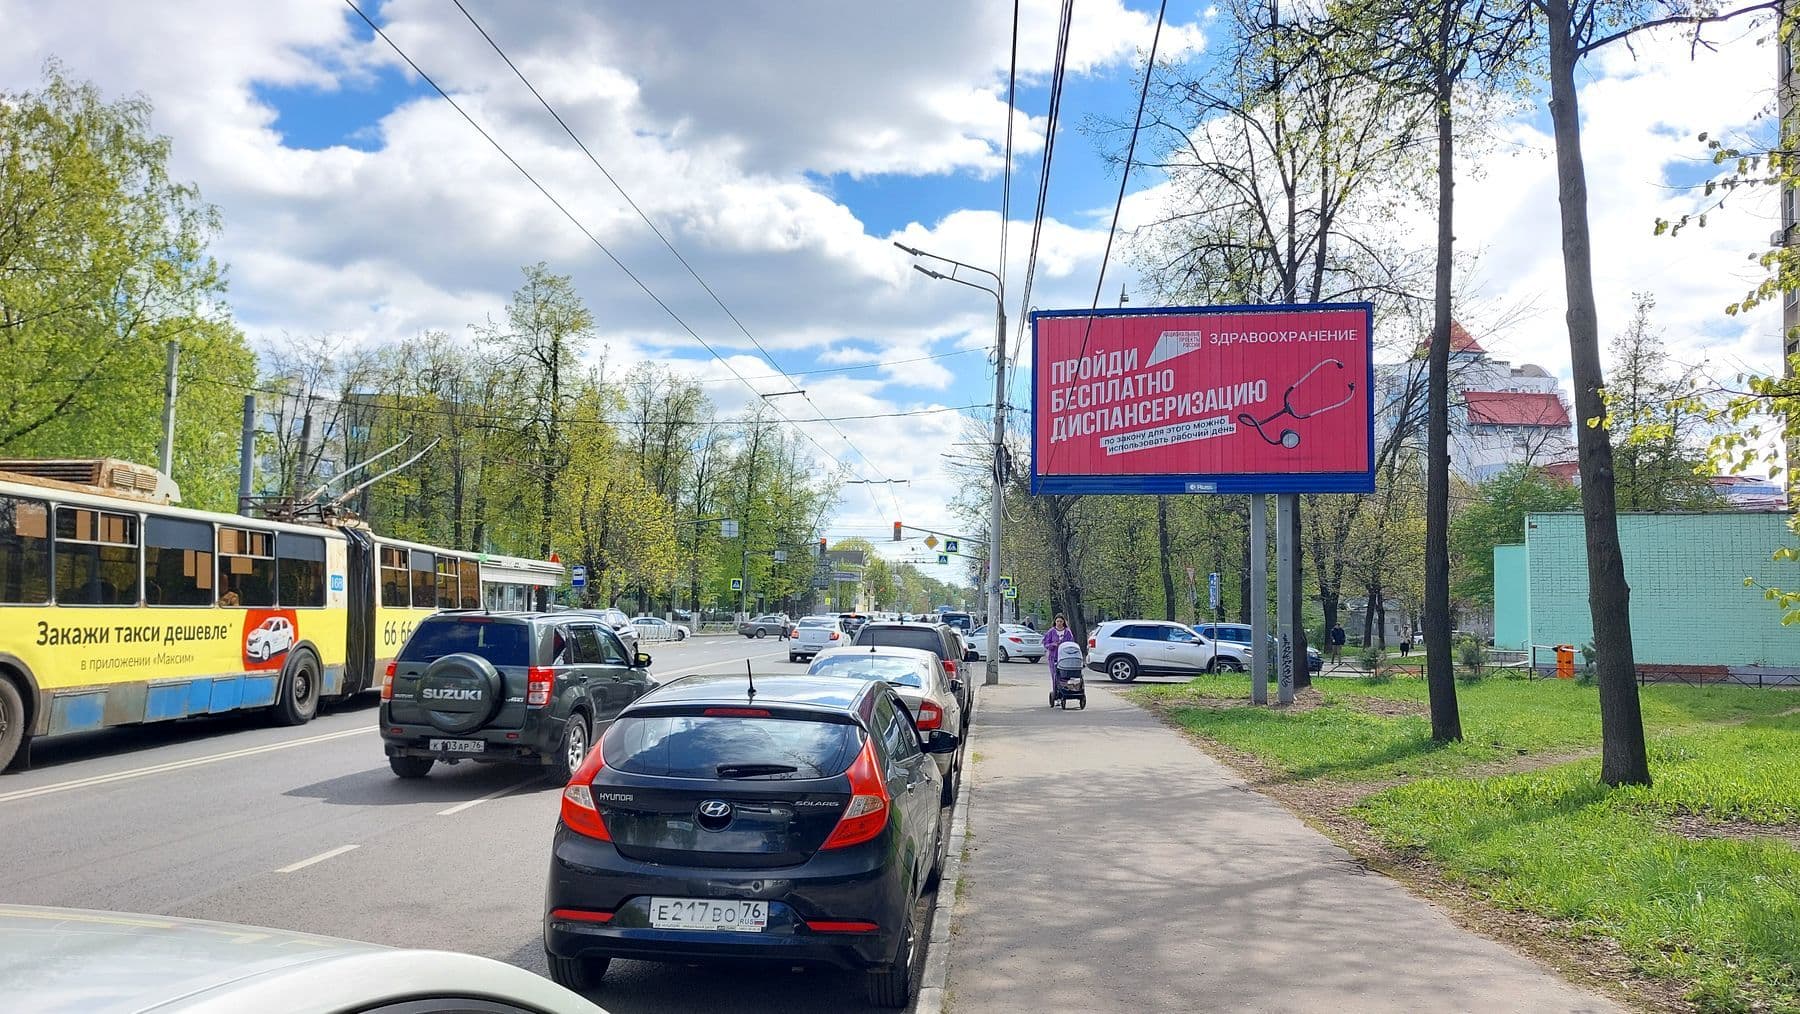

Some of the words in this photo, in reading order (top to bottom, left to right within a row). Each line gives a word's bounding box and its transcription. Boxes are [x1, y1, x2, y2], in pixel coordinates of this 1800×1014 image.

[1209, 329, 1358, 346] ЗДРАВООХРАНЕНИЕ
[1051, 347, 1138, 385] ПРОЙДИ
[1051, 369, 1175, 413] БЕСПЛАТНО
[1050, 379, 1267, 444] ДИСПАНСЕРИЗАЦИЮ
[1104, 438, 1115, 446] по
[1116, 432, 1146, 443] закону
[1147, 429, 1164, 439] для
[1166, 423, 1191, 435] этого
[1193, 418, 1226, 429] можно
[1108, 436, 1169, 453] использовать
[1171, 429, 1209, 443] рабочий
[1211, 425, 1235, 436] день
[36, 620, 110, 647] Закажи
[114, 625, 161, 643] такси
[384, 620, 397, 646] 66
[80, 659, 87, 671] в
[89, 658, 151, 672] приложении
[152, 652, 195, 666] «Максим»
[422, 688, 482, 701] SUZUKI
[599, 792, 633, 802] HYUNDAI
[742, 902, 761, 918] 76
